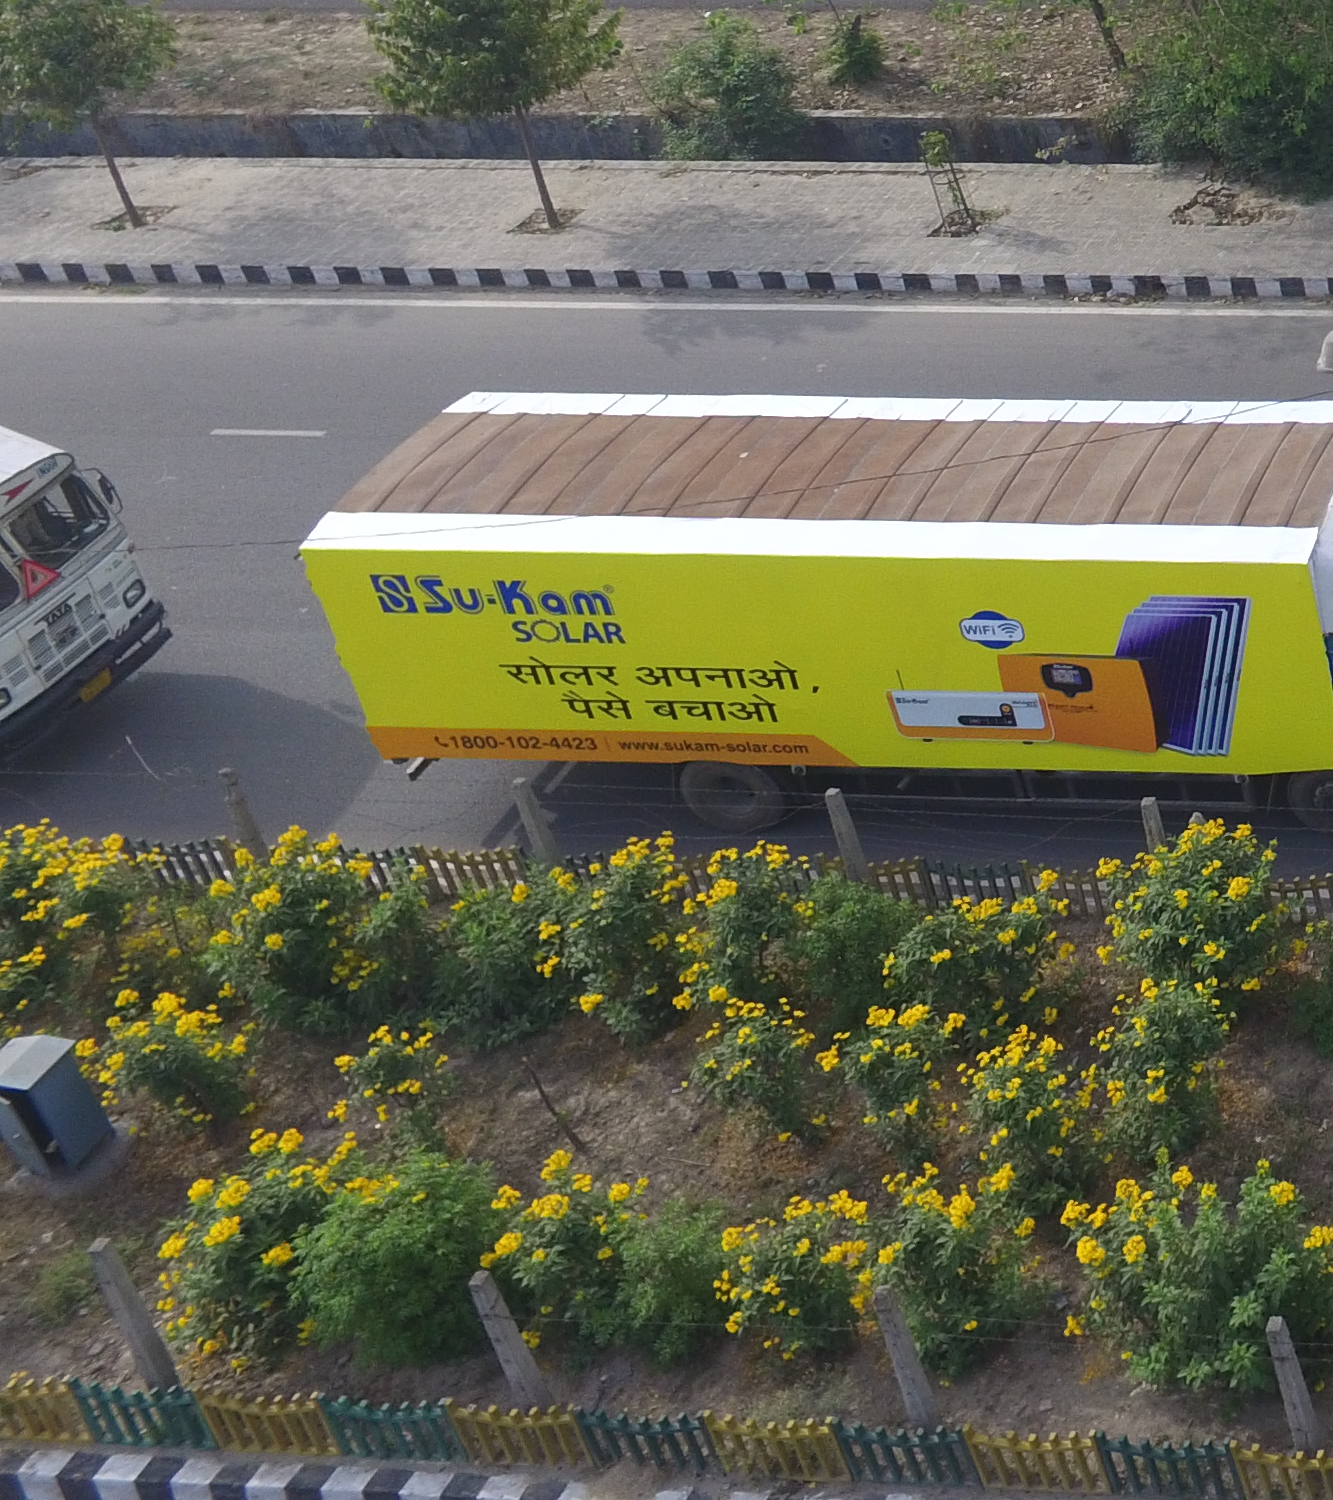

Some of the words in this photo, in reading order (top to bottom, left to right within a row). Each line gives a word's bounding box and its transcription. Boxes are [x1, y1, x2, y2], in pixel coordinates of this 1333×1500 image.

[511, 619, 626, 644] SOLAR
[499, 655, 619, 687] सोलर
[561, 690, 632, 720] पैसे
[645, 693, 778, 723] बचाओ
[449, 735, 598, 750] 1800-102-4423
[618, 738, 809, 755] www.sukam-solar.com
